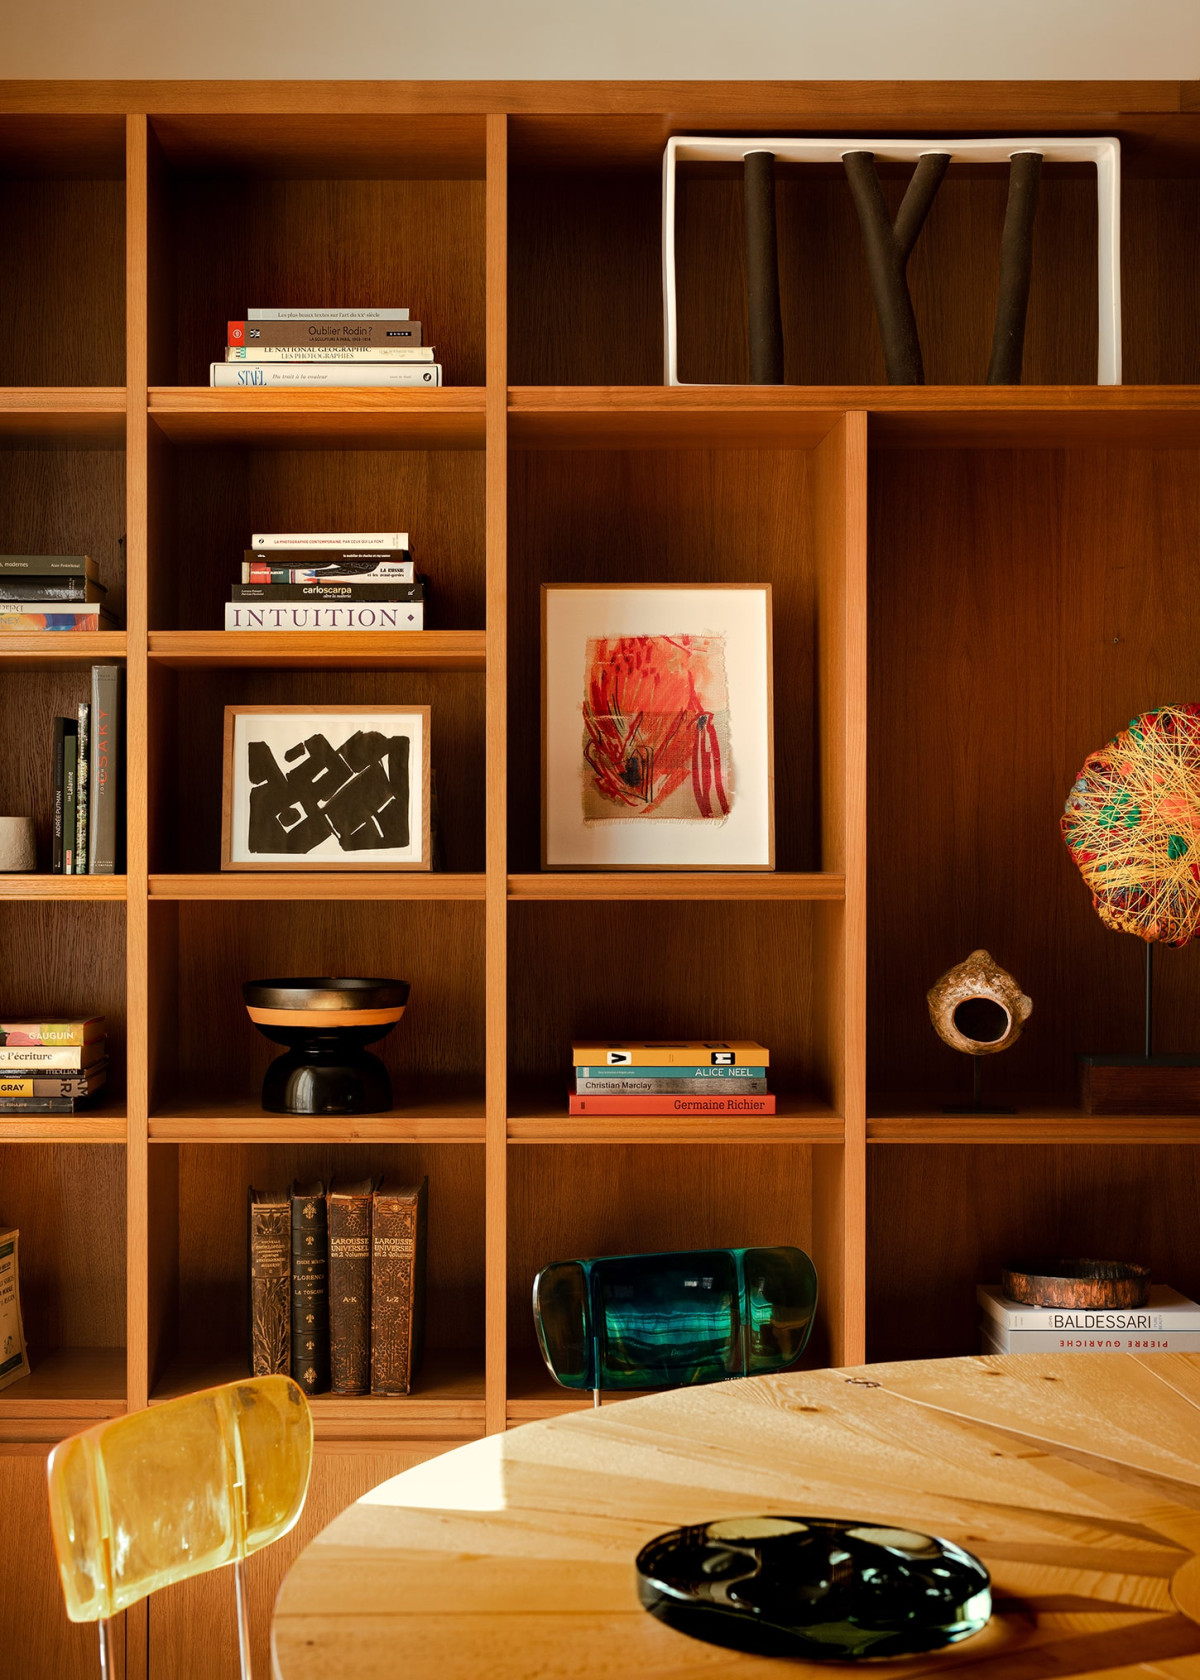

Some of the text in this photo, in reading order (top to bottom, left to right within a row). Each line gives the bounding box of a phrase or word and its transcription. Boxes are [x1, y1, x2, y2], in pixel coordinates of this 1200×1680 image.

[308, 326, 340, 335] Oublier
[303, 586, 352, 594] carloscarpa
[233, 609, 398, 627] INTUITION
[8, 1052, 53, 1060] l'écriture
[695, 1068, 754, 1076] ALICE NEEL
[621, 1082, 652, 1090] Marclay
[674, 1099, 765, 1110] Germaine Richier
[1054, 1315, 1151, 1328] BALDESSARI
[1060, 1340, 1168, 1348] PIERRE GUARICHE
